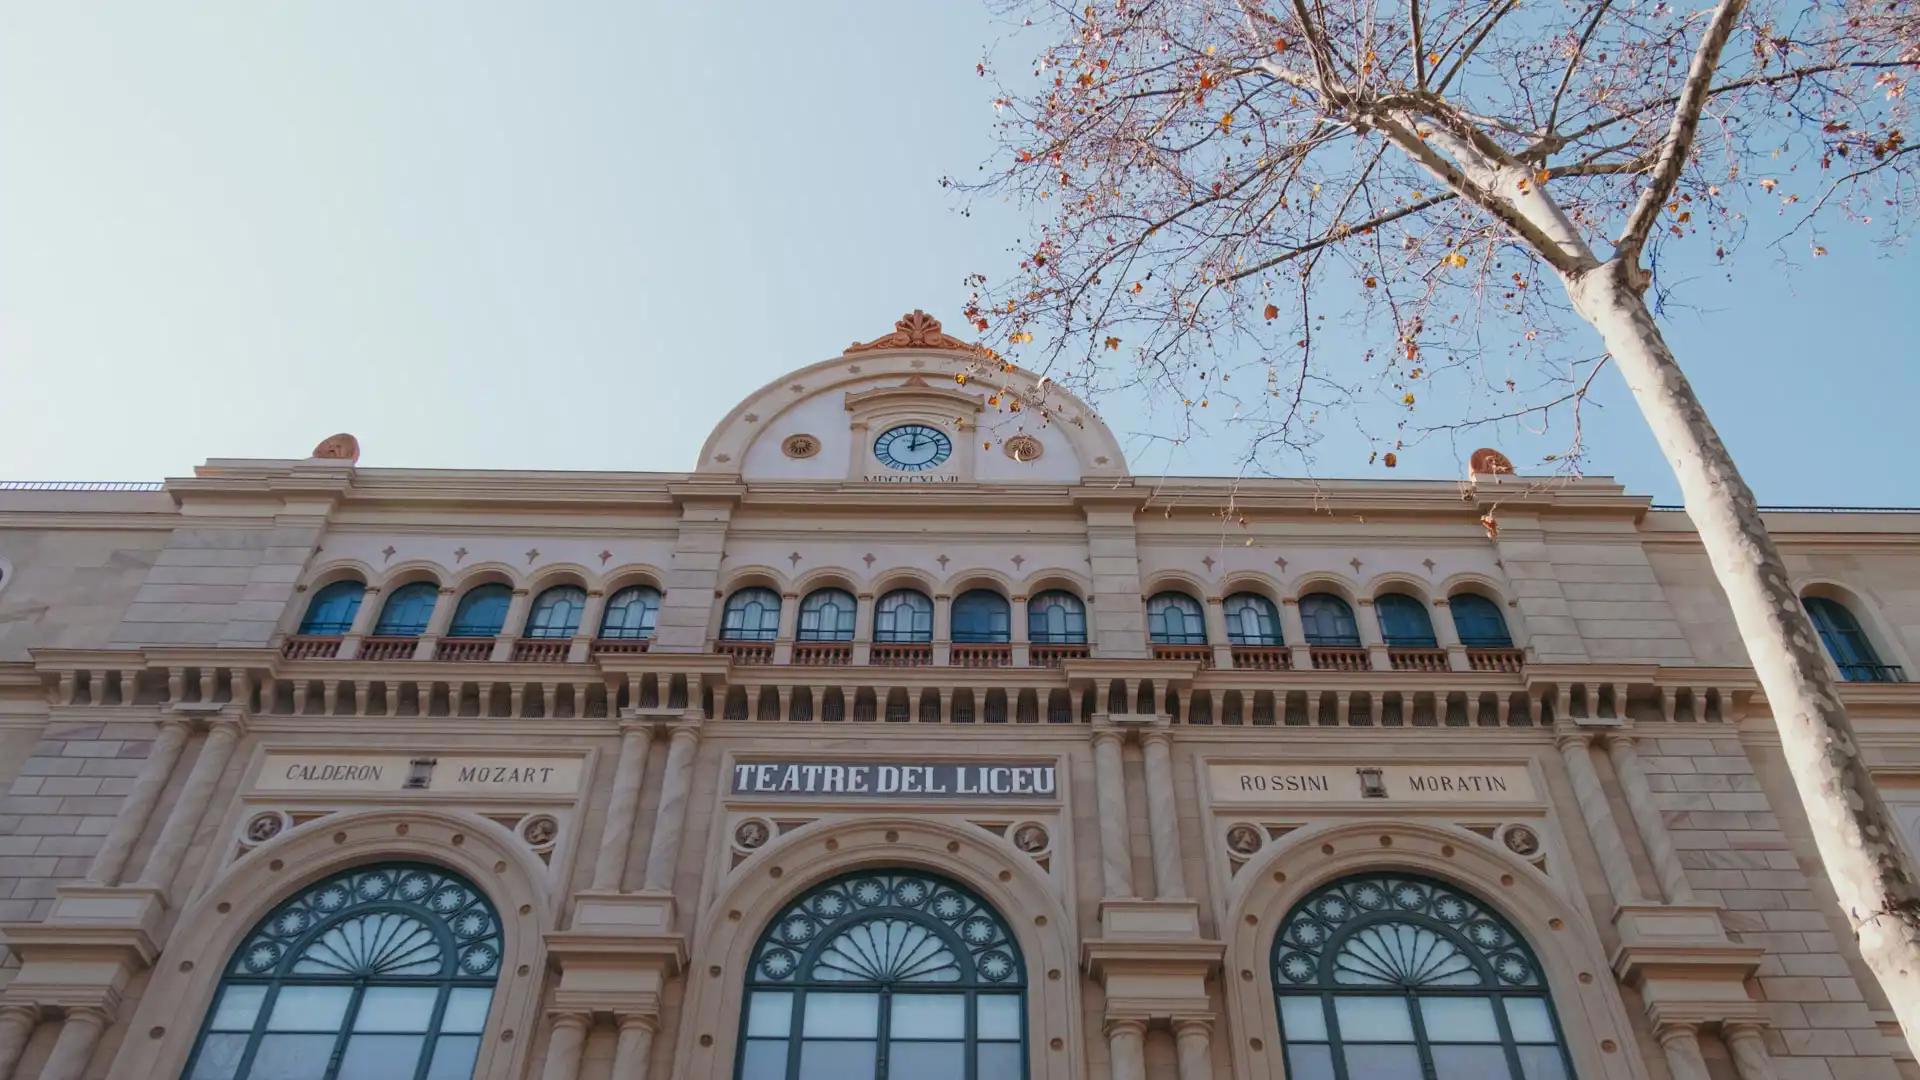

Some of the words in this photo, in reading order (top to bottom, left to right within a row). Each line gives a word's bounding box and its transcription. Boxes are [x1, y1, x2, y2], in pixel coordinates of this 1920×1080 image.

[286, 764, 383, 780] CALDERON
[457, 767, 554, 783] MOZART
[735, 764, 869, 792] TEATRE
[877, 766, 946, 793] DEL
[955, 767, 1055, 794] LICEU
[1240, 775, 1329, 791] ROSSINI
[1408, 776, 1506, 792] MORATIN
